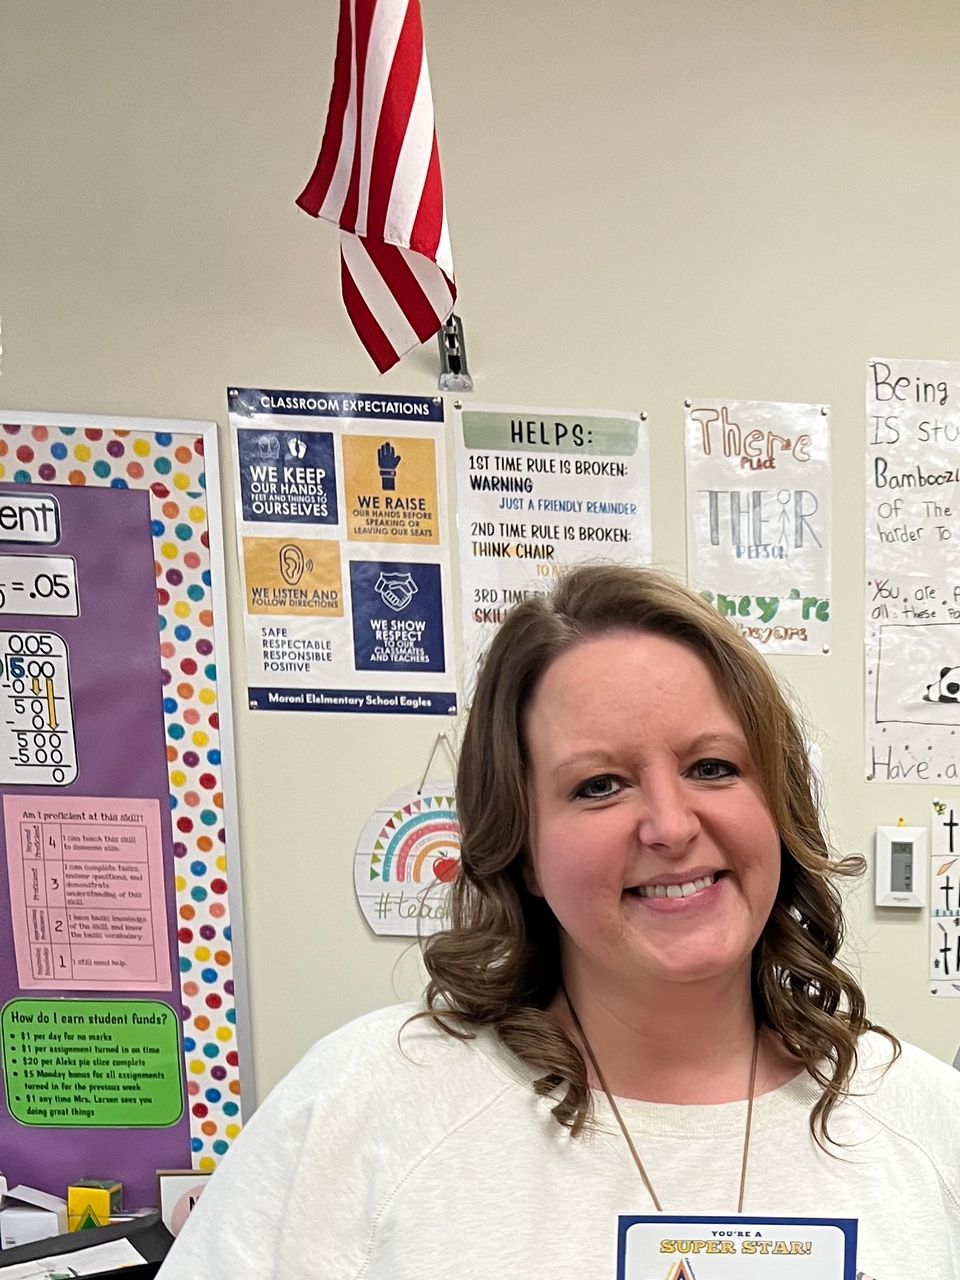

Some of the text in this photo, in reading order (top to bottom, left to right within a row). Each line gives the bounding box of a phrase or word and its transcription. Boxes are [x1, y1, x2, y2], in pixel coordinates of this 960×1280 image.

[870, 362, 948, 405] Being
[261, 397, 429, 415] CLASSROOM EXPECTATIONS
[511, 420, 592, 446] HELPS:
[691, 407, 812, 462] There
[469, 456, 628, 477] 1ST TIME RULE IS BROKEN:
[250, 466, 325, 484] WE KEEP
[251, 483, 327, 496] OUR HANDS,
[470, 475, 533, 492] WARNING
[252, 502, 328, 516] OURSELVES
[358, 496, 425, 510] WE RAISE
[500, 497, 637, 515] JUST A FRIENDLY REMINDER
[924, 501, 952, 518] The
[366, 518, 405, 526] SPEAKING
[354, 527, 387, 535] LEAVING
[391, 528, 407, 536] OUR
[471, 522, 632, 542] 2ND TIME RULE IS BROKEN:
[472, 542, 554, 560] THINK CHAIR
[29, 574, 70, 599] .05
[872, 580, 899, 602] You
[914, 585, 936, 600] are
[252, 587, 338, 600] WE LISTEN AND
[474, 589, 498, 602] 3RD
[252, 598, 338, 608] FOLLOW DIRECTIONS
[370, 620, 425, 631] WE SHOW
[262, 628, 287, 637] SAFE
[376, 629, 422, 641] RESPECT
[8, 635, 52, 654] 0.05
[262, 640, 331, 650] RESPECTABLE
[384, 640, 394, 648] TO
[263, 650, 332, 661] RESPONSIBLE
[374, 647, 424, 655] CLASSMATES
[370, 654, 430, 663] AND TEACHERS
[264, 662, 310, 672] POSITIVE
[269, 693, 304, 704] Moroni
[366, 695, 398, 706] School
[400, 697, 431, 708] Eagles
[872, 746, 930, 780] Have
[23, 811, 36, 819] Am
[43, 812, 86, 821] proficient
[89, 812, 97, 820] at
[100, 813, 118, 821] this
[49, 837, 55, 848] 4
[51, 878, 59, 890] 3
[55, 921, 63, 932] 2
[59, 955, 66, 968] 1
[12, 1011, 167, 1025] How do I earn student funds?
[21, 1032, 30, 1041] $1
[34, 1033, 45, 1042] per
[48, 1032, 61, 1042] day
[89, 1033, 112, 1041] marks
[660, 1239, 812, 1255] SUPER STAR!
